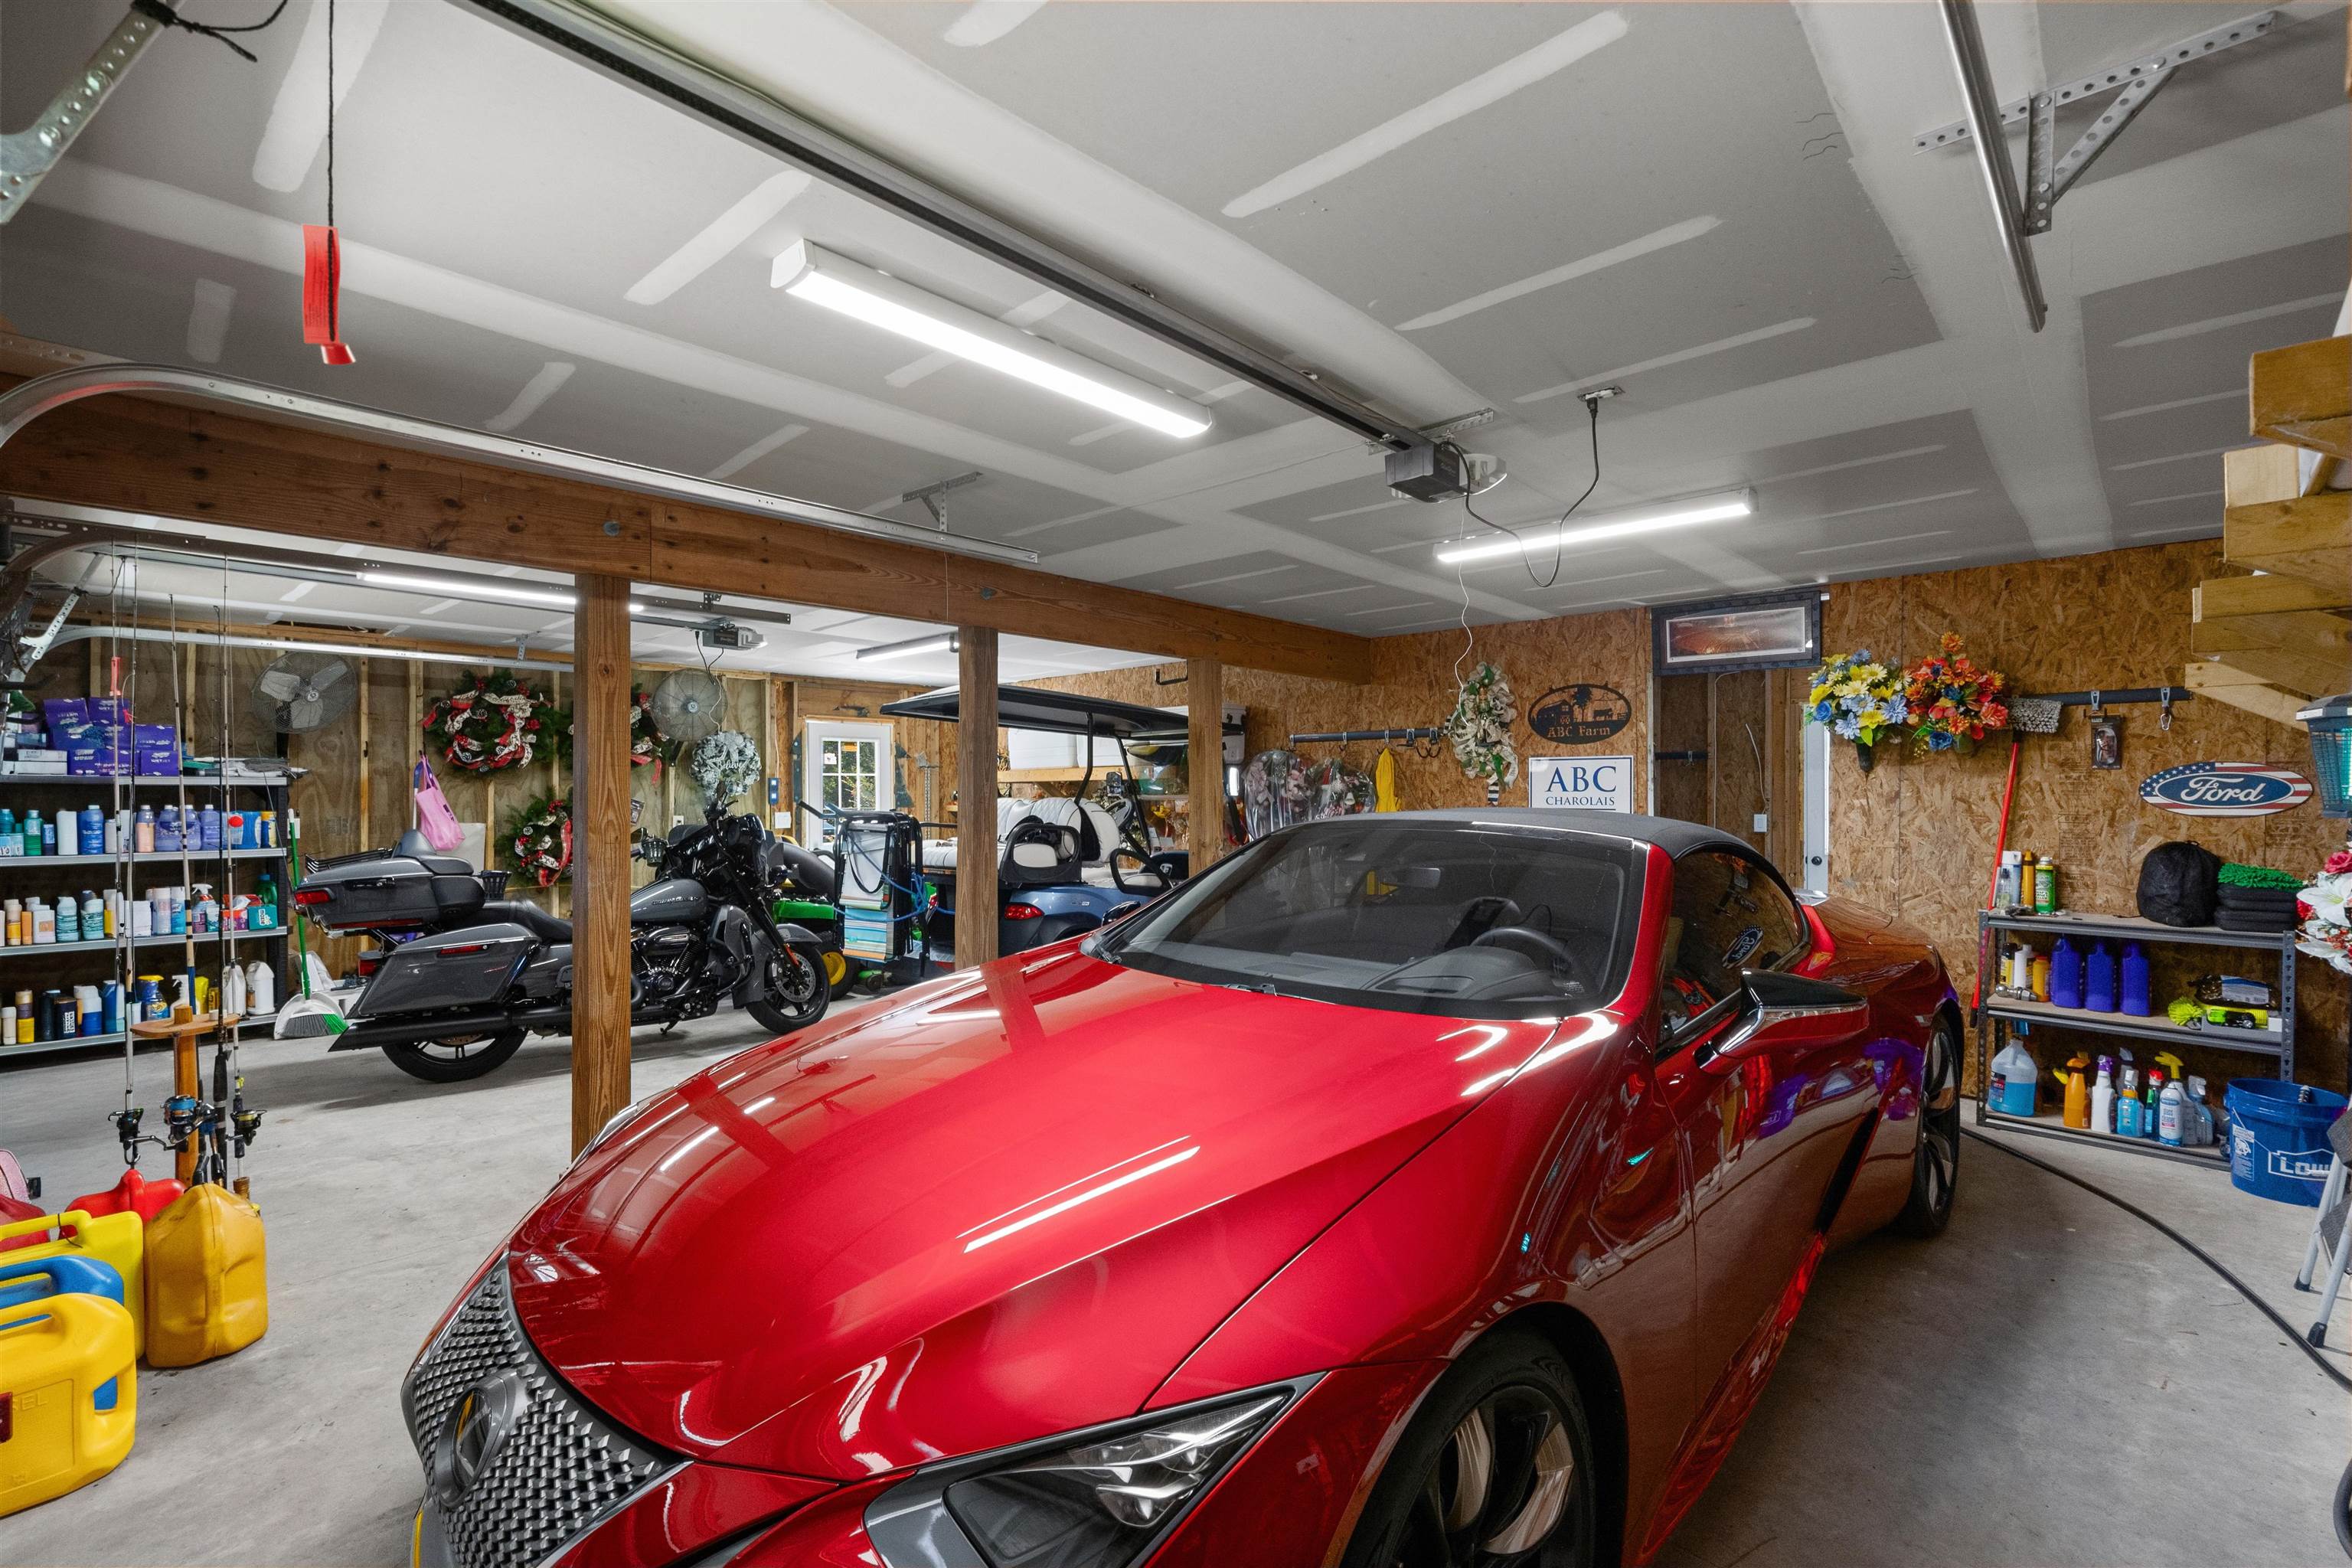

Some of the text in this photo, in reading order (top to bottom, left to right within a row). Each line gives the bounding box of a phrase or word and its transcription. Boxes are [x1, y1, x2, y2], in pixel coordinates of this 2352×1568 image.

[1547, 725, 1610, 737] ABC Farm
[1544, 766, 1616, 792] ABC
[2180, 776, 2267, 802] Ford
[1546, 796, 1615, 805] CHAROLAIS
[2281, 1156, 2330, 1176] LOW
